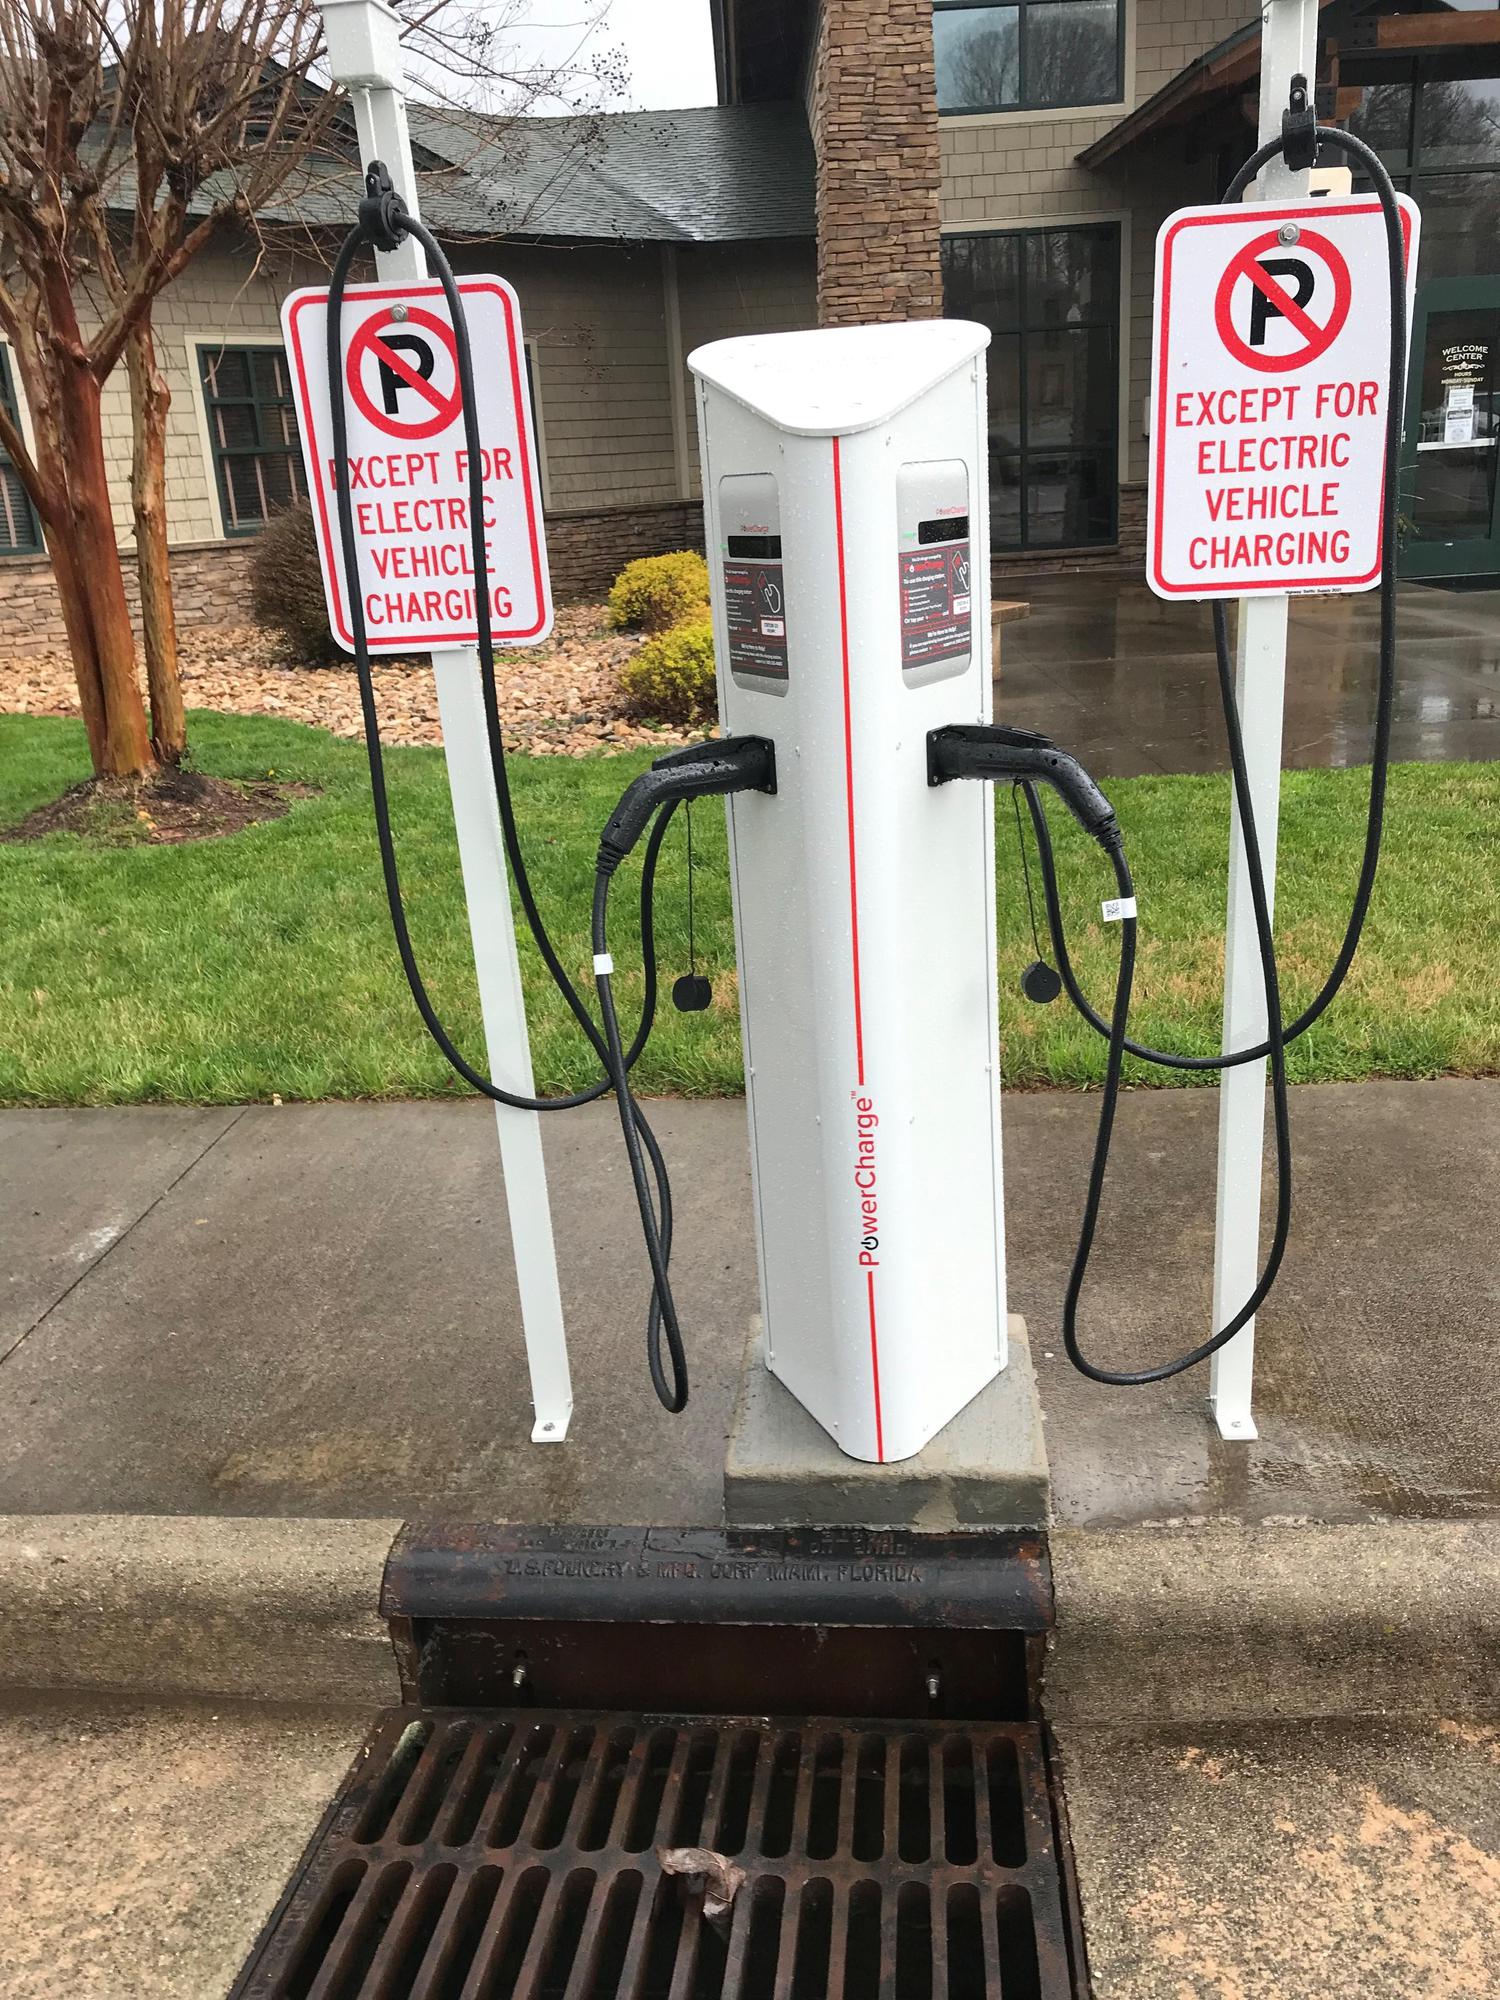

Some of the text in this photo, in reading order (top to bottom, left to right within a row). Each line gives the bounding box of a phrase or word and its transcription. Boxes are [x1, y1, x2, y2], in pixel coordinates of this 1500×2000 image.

[1442, 344, 1489, 355] WELCOME
[1446, 352, 1483, 362] CENTER
[1175, 381, 1380, 427] EXCEPT FOR
[1197, 433, 1350, 475] ELECTRIC
[356, 495, 497, 536] ELECTRC
[1205, 483, 1340, 522] VEHICLE
[1189, 530, 1350, 571] CHARGING
[366, 585, 513, 625] CHARGIG
[838, 1564, 924, 1583] FLORIDA
